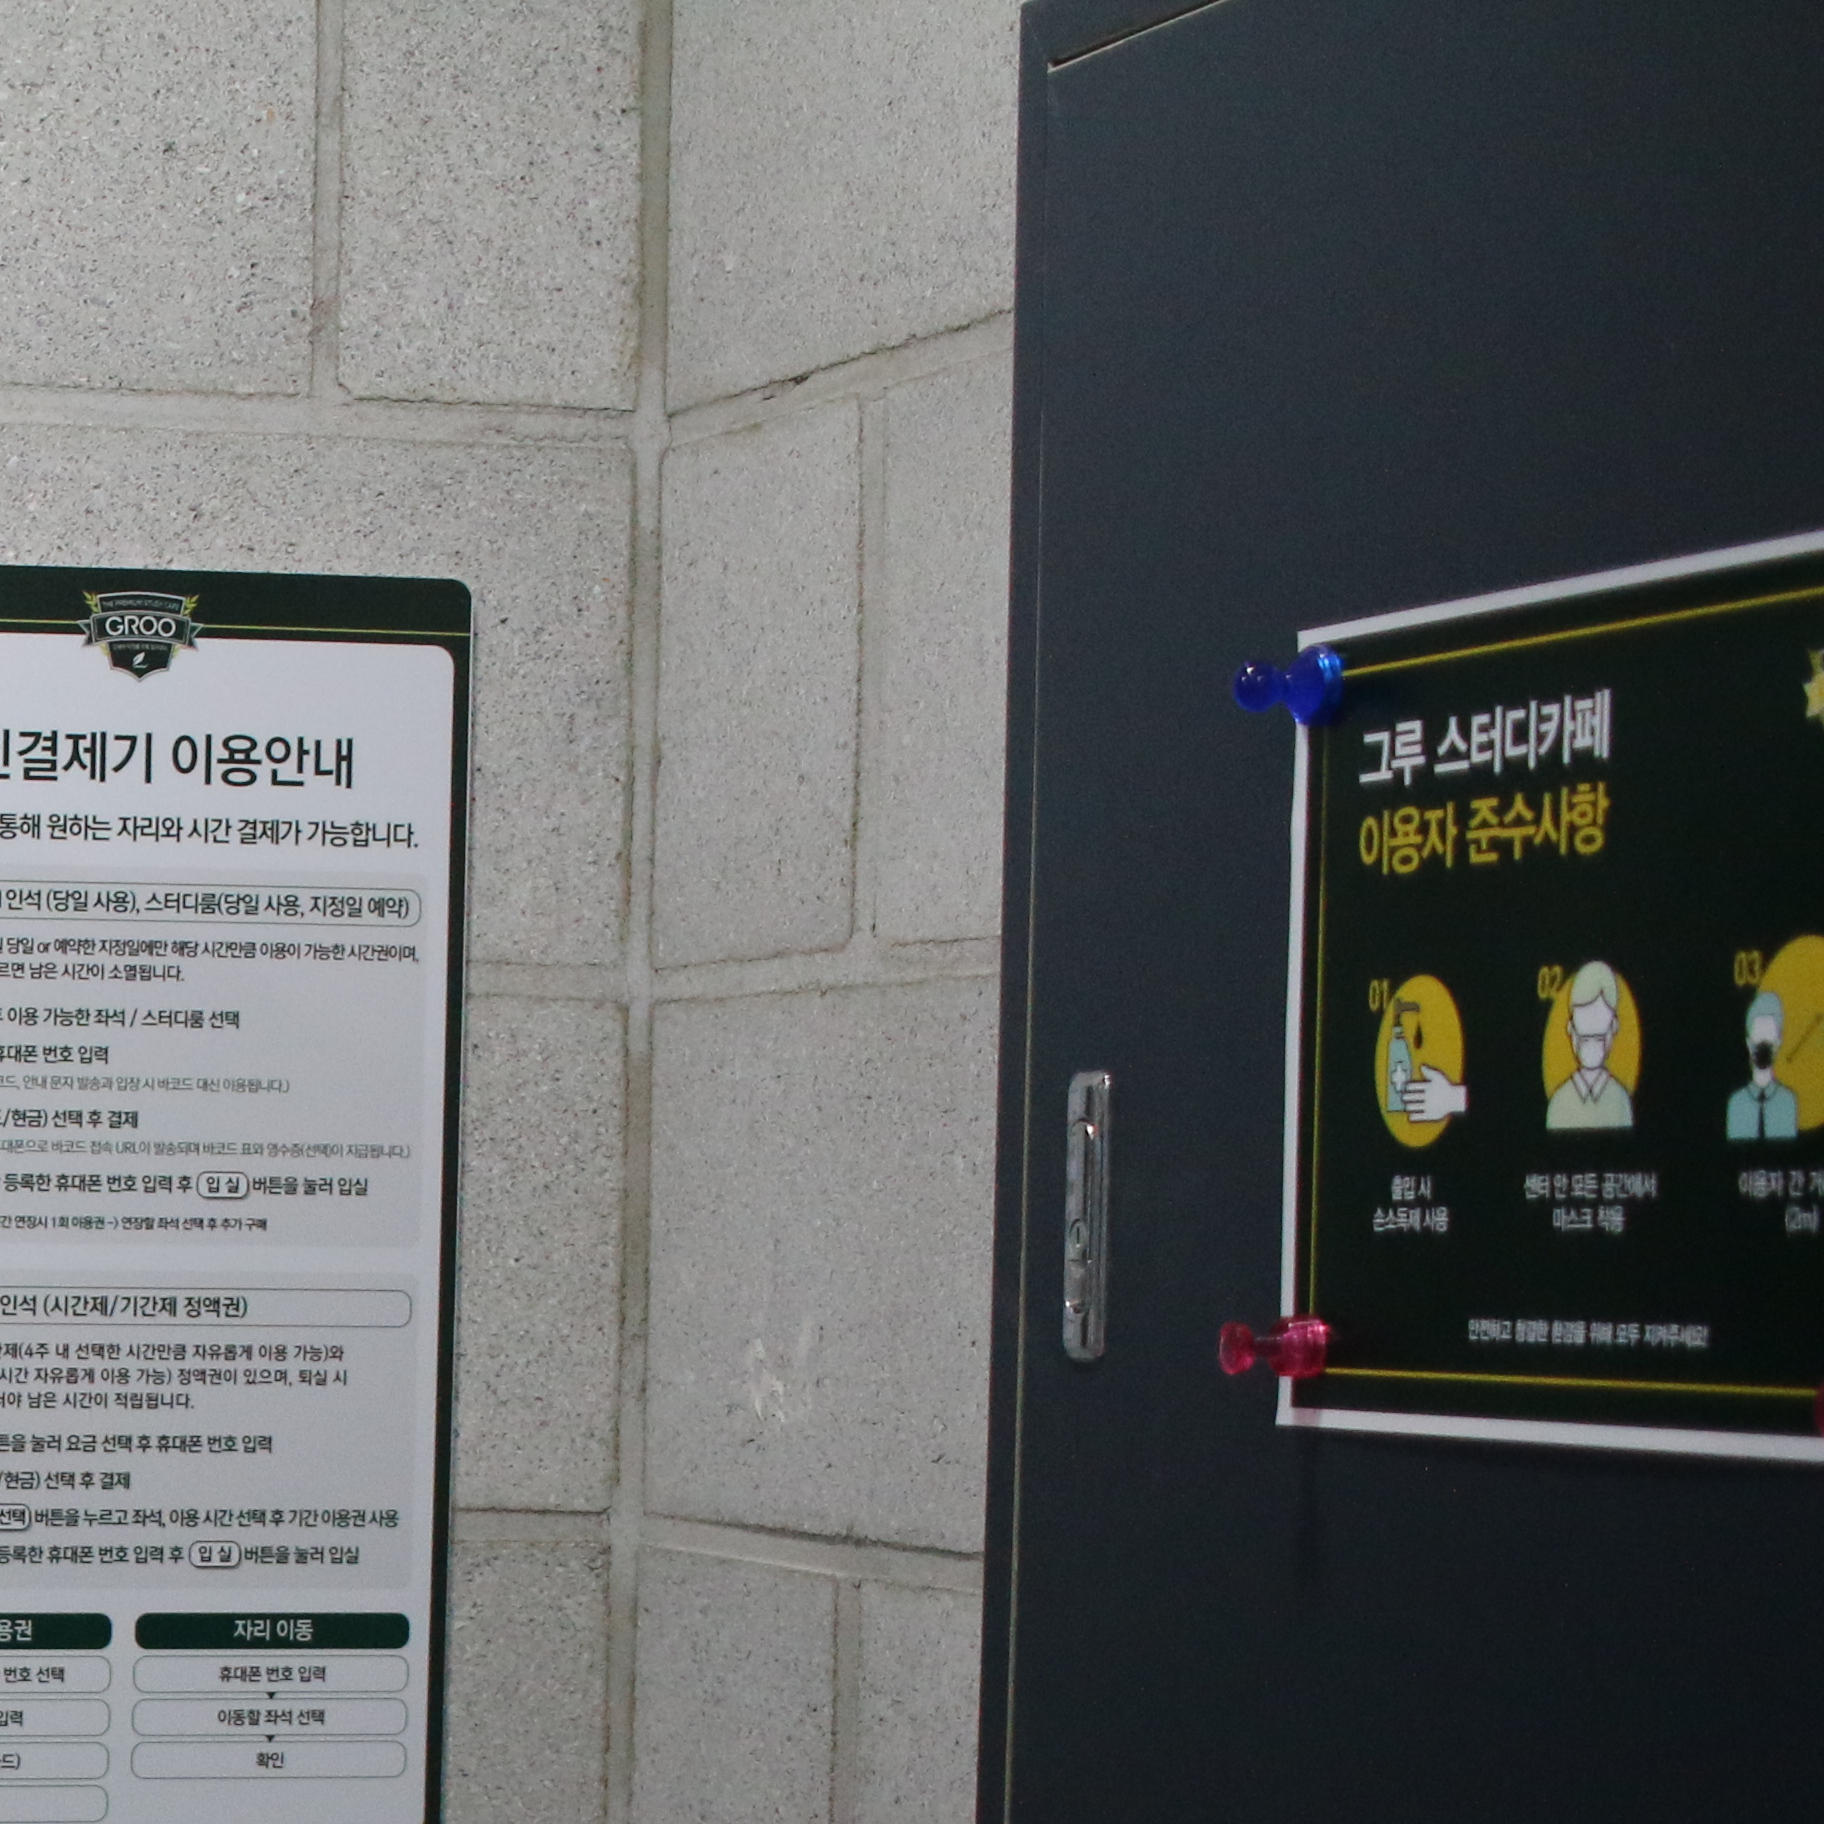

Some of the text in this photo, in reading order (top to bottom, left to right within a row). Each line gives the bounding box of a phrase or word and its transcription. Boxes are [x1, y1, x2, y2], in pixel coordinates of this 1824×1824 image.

[105, 615, 176, 637] GROO
[1359, 688, 1612, 786] 그루 스터디카페
[171, 735, 354, 789] 이용안내
[46, 814, 112, 843] 원하는
[117, 815, 183, 844] 자리와
[188, 817, 232, 845] 시간
[237, 818, 302, 847] 결제가
[307, 819, 420, 850] 가능합니다.
[1359, 781, 1611, 876] 이용자 준수사항
[46, 890, 89, 913] (당일
[144, 892, 260, 916] 스터디룸(당일
[264, 894, 305, 918] 사용,
[309, 895, 363, 918] 지정일
[367, 896, 410, 920] 예약)
[1734, 950, 1762, 987] 03
[1368, 978, 1390, 1012] 01
[1537, 965, 1563, 1000] 02
[7, 1008, 39, 1026] 이용
[43, 1008, 91, 1027] 가능한
[95, 1009, 125, 1027] 좌석
[141, 1009, 204, 1028] 스터디룸
[209, 1010, 240, 1029] 선택
[1552, 1206, 1594, 1232] 마스크
[43, 1296, 177, 1318] (시간제/기간제
[183, 1296, 248, 1318] 정액권)
[233, 1619, 314, 1641] 자리 이동
[3, 1667, 33, 1683] 번호
[36, 1667, 66, 1683] 선택
[218, 1666, 327, 1683] 휴대폰 번호 입력
[218, 1709, 326, 1726] 이동할 좌석 선택
[256, 1752, 285, 1769] 확인
